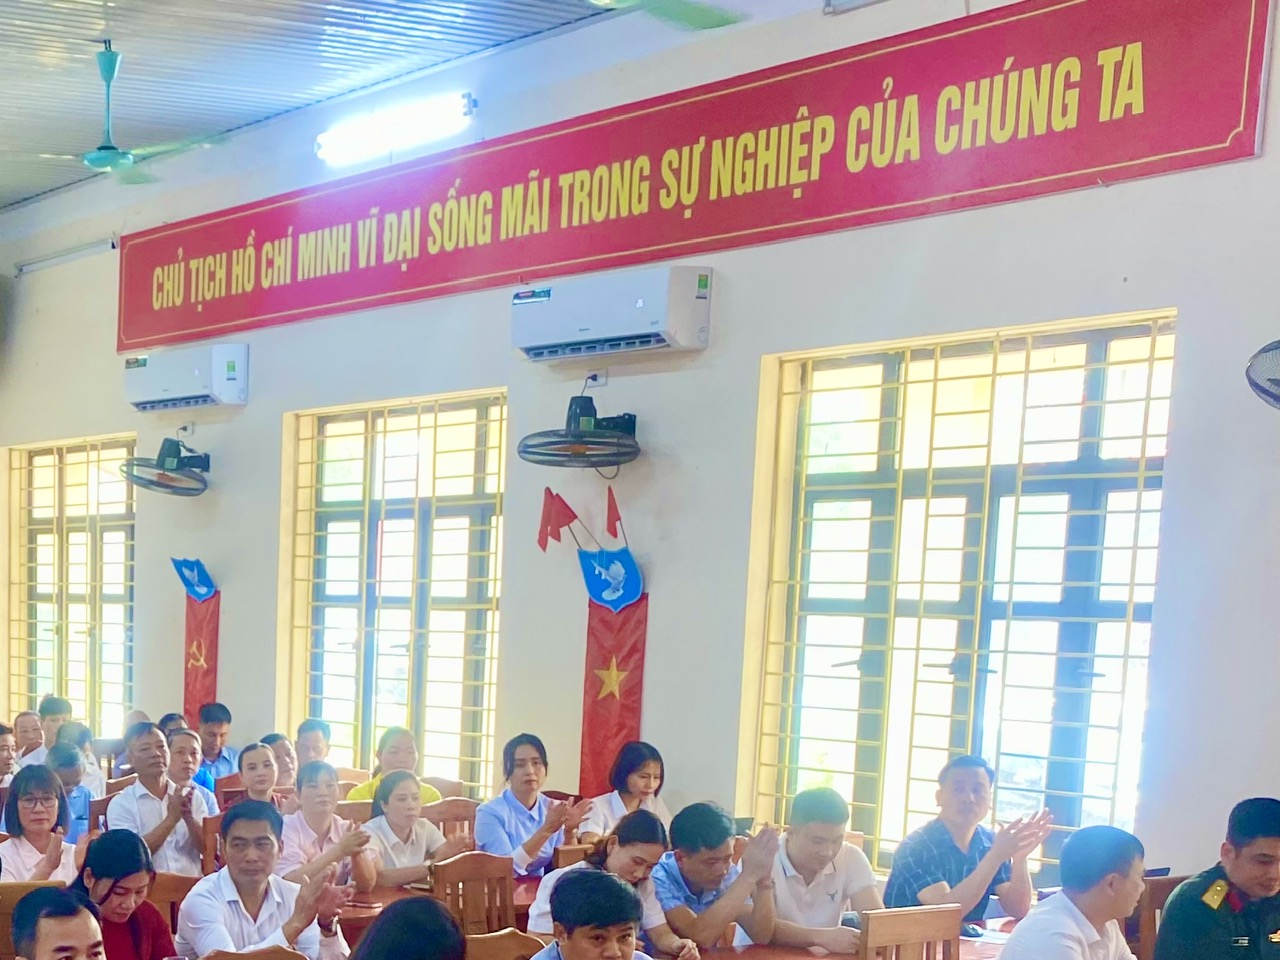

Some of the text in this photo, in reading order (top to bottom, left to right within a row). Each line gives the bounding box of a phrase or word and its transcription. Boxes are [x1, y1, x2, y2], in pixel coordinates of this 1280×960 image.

[152, 41, 1145, 312] CHỦ TỊCH HỒ CHÍ MINH VĨ ĐẠI SỐNG MÃI TRONG SỰ NGHIỆP CỦA CHÚNG TA
